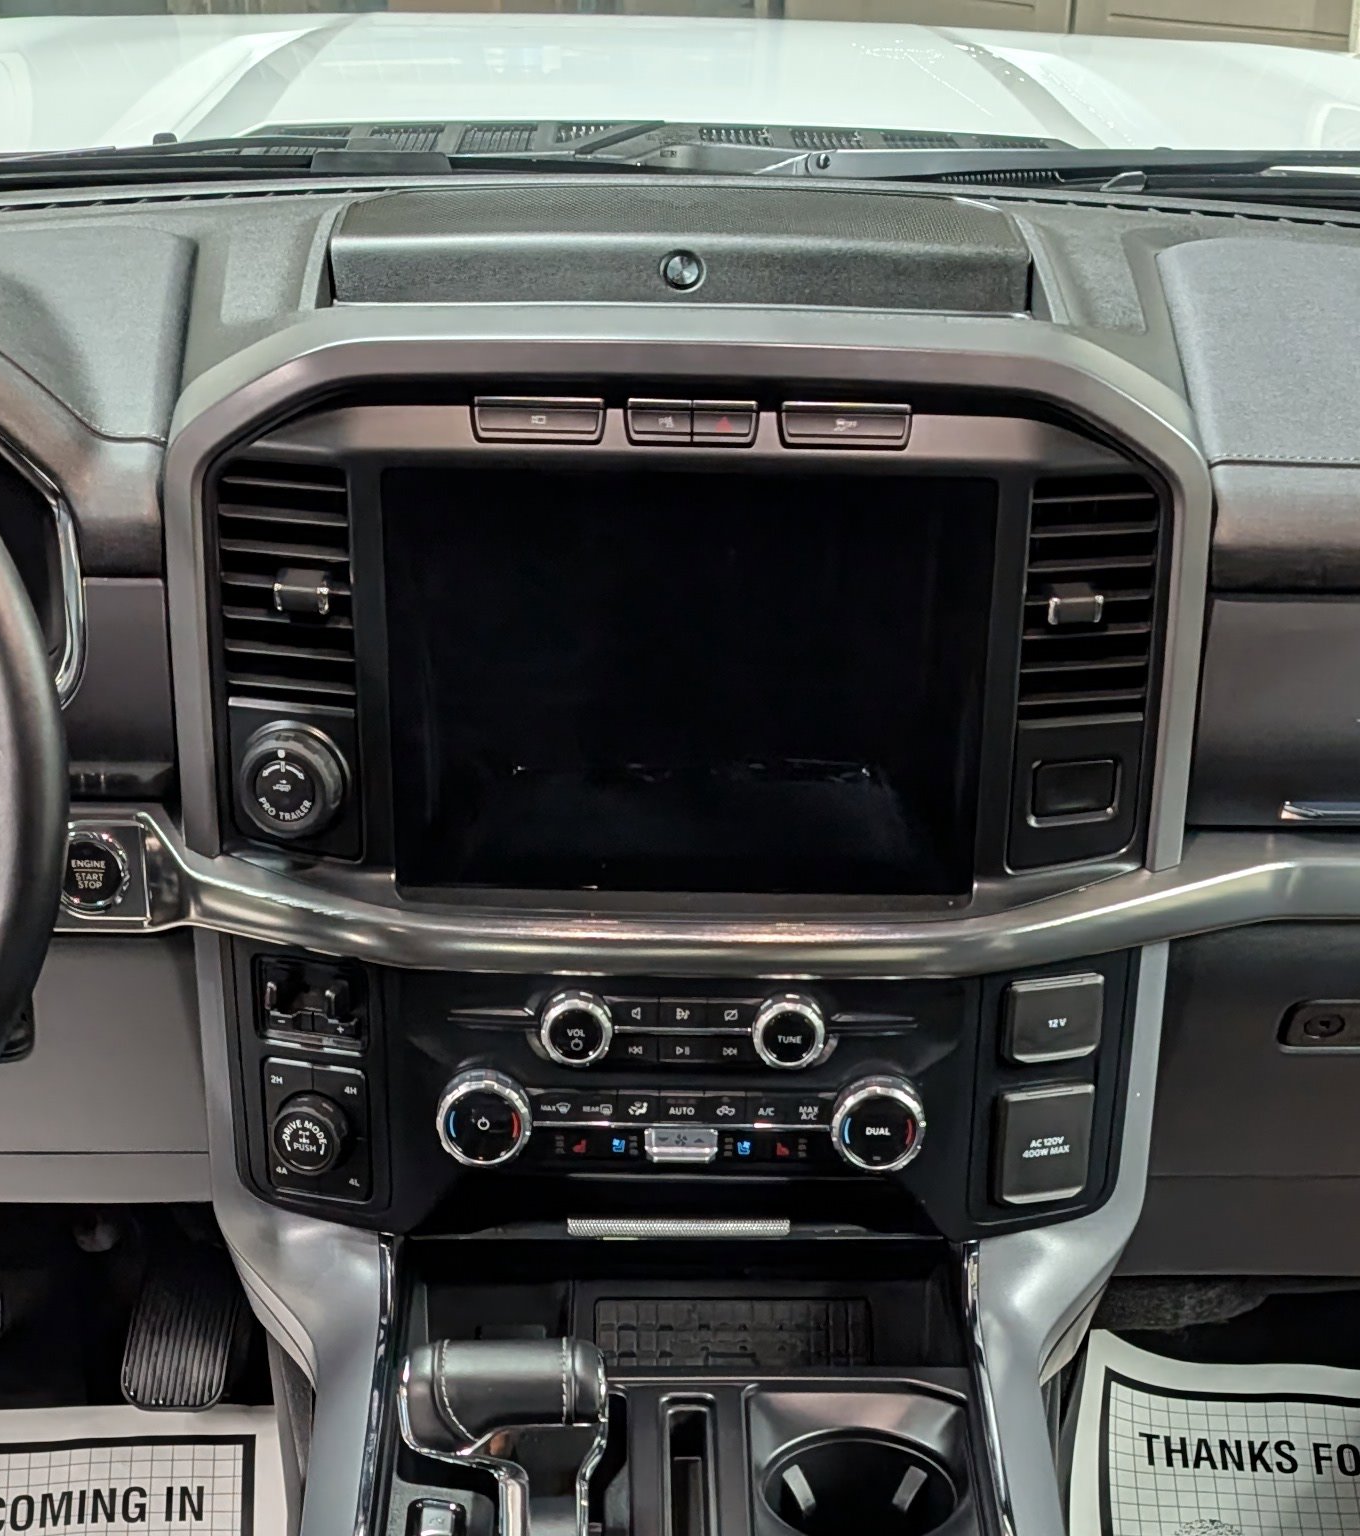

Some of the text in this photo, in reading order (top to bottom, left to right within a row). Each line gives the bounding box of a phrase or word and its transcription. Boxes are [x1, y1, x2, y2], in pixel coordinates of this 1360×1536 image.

[258, 797, 312, 820] PRO TRAILER
[70, 859, 106, 869] ENGINE
[75, 872, 103, 881] START
[77, 880, 102, 889] STOP
[566, 1028, 586, 1037] VOL
[777, 1035, 802, 1044] TUNE
[270, 1075, 283, 1084] 2H
[344, 1086, 357, 1095] 4H
[668, 1106, 695, 1116] AUTO
[757, 1107, 775, 1116] A/C
[799, 1105, 819, 1114] MAX
[801, 1112, 817, 1121] A/C
[282, 1119, 328, 1145] DRIVE MODE
[865, 1127, 891, 1136] DUAL
[1030, 1136, 1065, 1148] AC 120V
[293, 1142, 317, 1152] PUSH
[1022, 1144, 1070, 1158] 400W MAX
[275, 1165, 288, 1175] 4A
[348, 1178, 361, 1187] 4L
[1138, 1432, 1299, 1475] THANKS
[164, 1485, 205, 1522] IN
